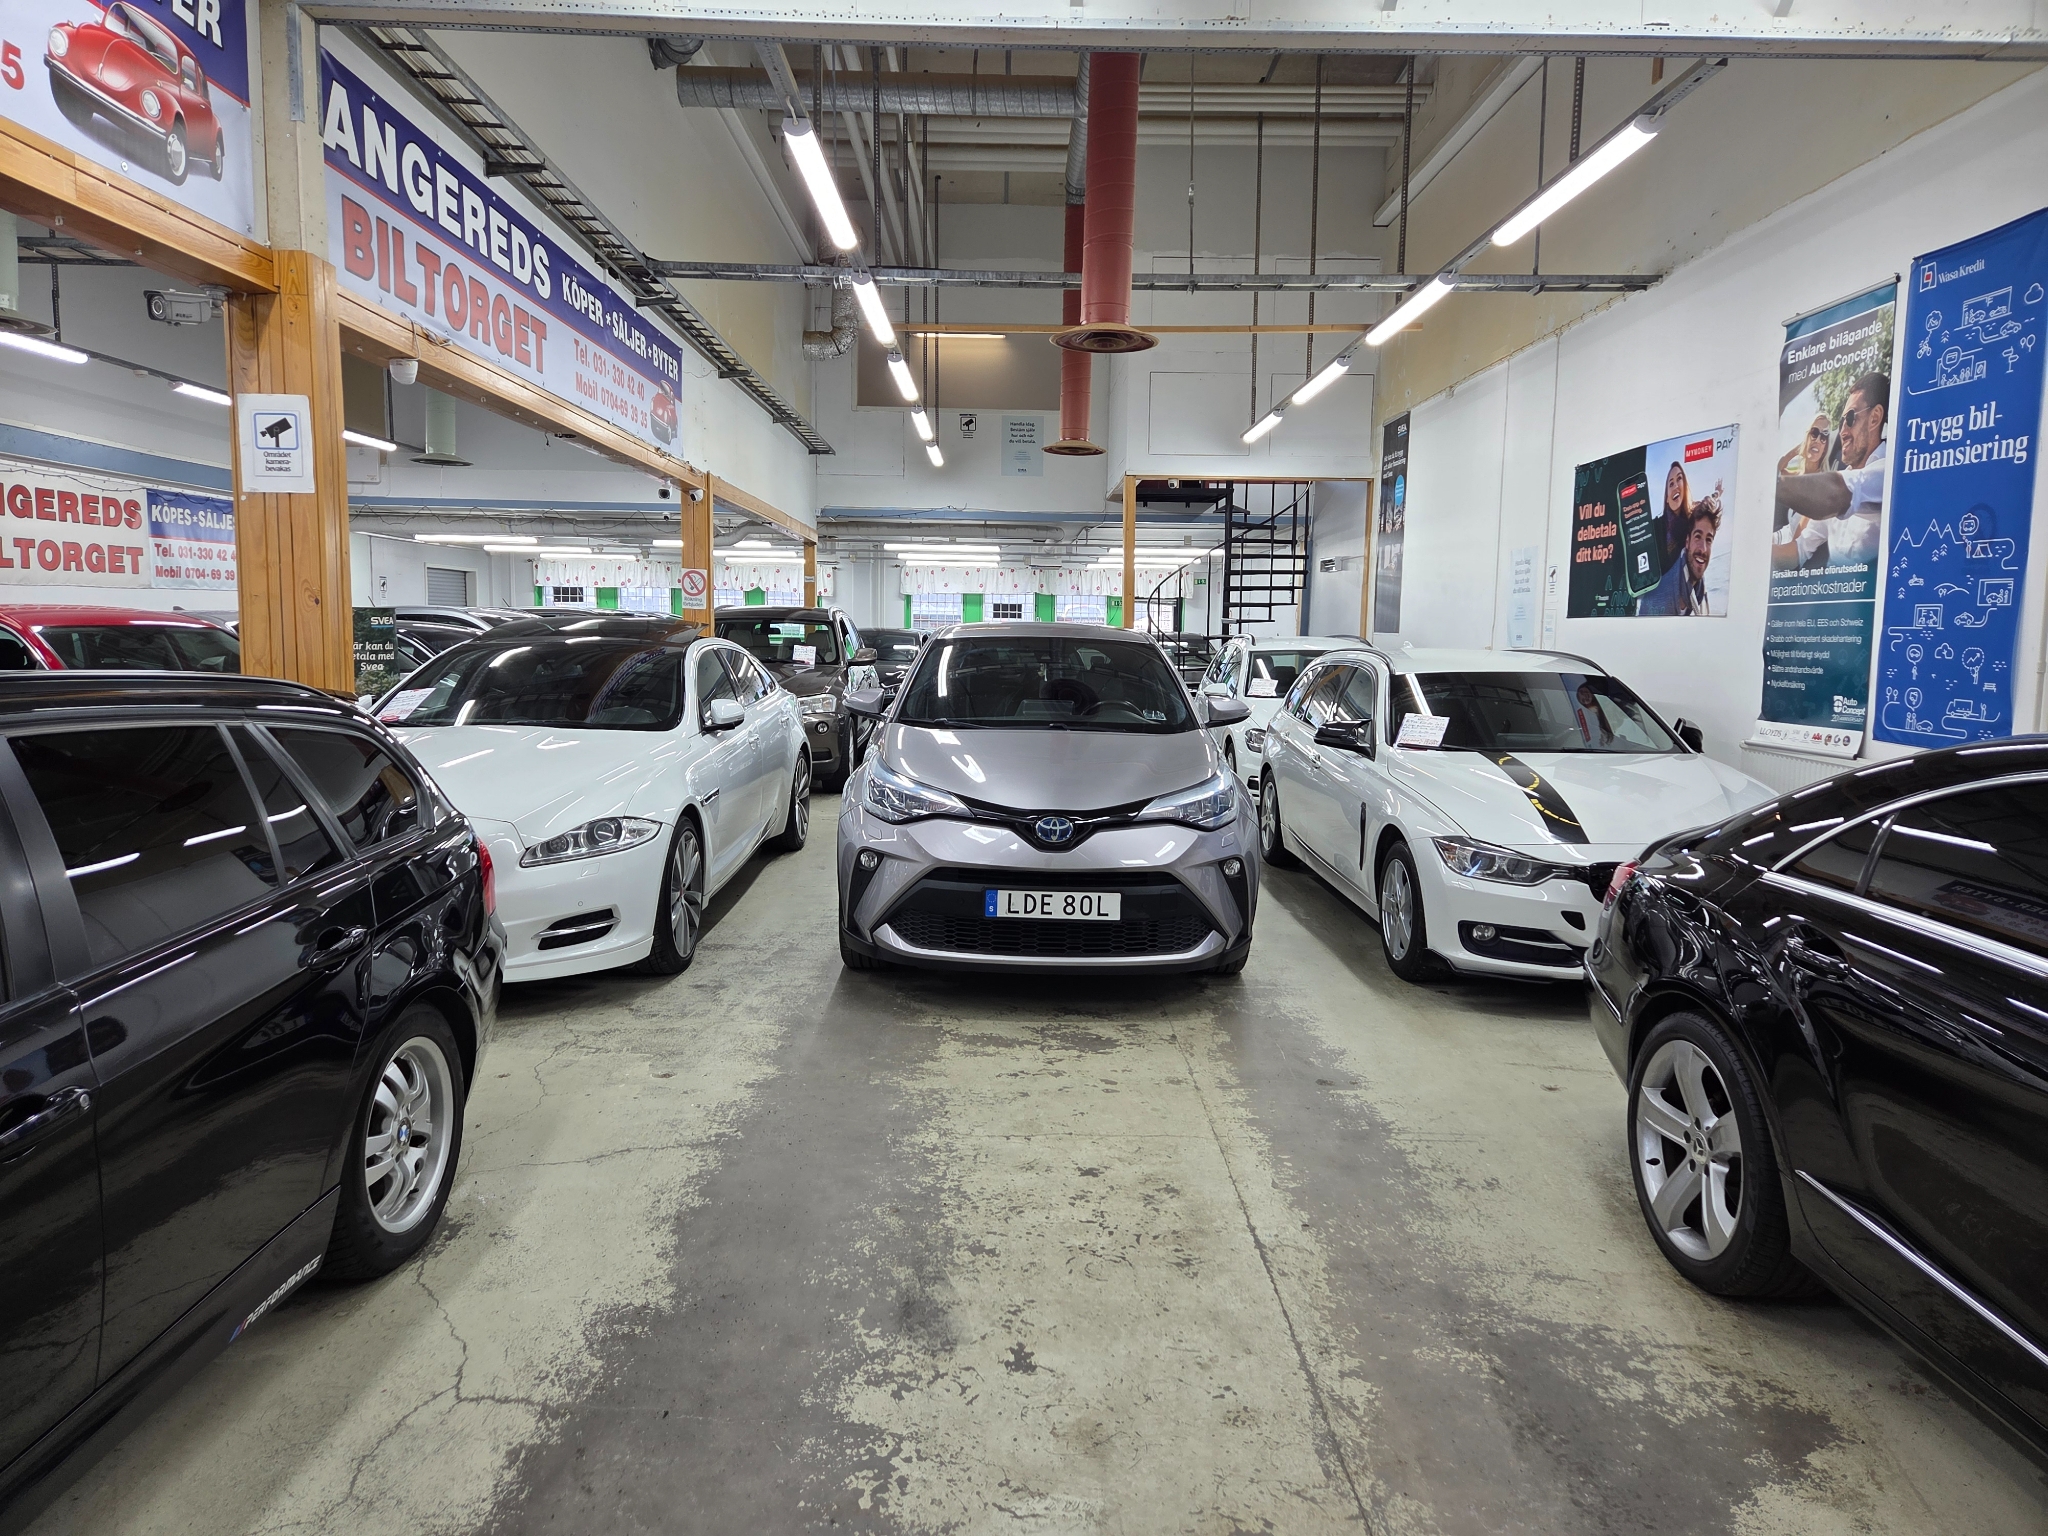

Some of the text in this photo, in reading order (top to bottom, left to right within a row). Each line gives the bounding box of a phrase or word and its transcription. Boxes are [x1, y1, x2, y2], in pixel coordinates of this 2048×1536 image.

[323, 80, 551, 300] ANGEREDS
[1938, 258, 1985, 284] Wasa Kredit
[341, 193, 547, 374] BILTORGET
[561, 272, 679, 382] KÖPER SÄLJER BYTER
[1787, 320, 1883, 365] Enklare bilägande
[573, 338, 590, 368] Tel.
[612, 363, 625, 389] 330
[626, 374, 635, 394] 42
[637, 380, 645, 401] 40
[1788, 341, 1880, 384] med AutoConcept
[575, 372, 648, 429] Mobil 0704-69 39 35
[1907, 401, 2003, 445] Trygg bil-
[1716, 437, 1734, 451] PAY
[1902, 435, 2029, 474] finansiering
[0, 482, 143, 530] GEREDS
[151, 503, 192, 526] KÖPES
[1579, 503, 1593, 520] Vill
[1593, 502, 1606, 518] du
[1577, 521, 1617, 542] delbetala
[154, 543, 174, 558] Tel.
[178, 545, 213, 560] 031-330
[217, 548, 227, 562] 42
[1575, 543, 1614, 564] ditt köp?
[155, 565, 235, 581] Mobil 0704-69 39
[1772, 562, 1868, 579] Försäkra dig mot oförutsedda
[1771, 578, 1867, 599] reparationskostnader
[370, 616, 394, 625] SVEA
[1806, 618, 1816, 628] EU,
[1817, 618, 1829, 627] EES
[1829, 618, 1839, 627] och
[1840, 617, 1864, 627] Schweiz
[353, 641, 394, 651] är kan du
[1770, 634, 1862, 645] Snabb och kompetent skadehantering
[353, 650, 395, 661] etala med
[1813, 650, 1830, 660] skydd
[360, 662, 384, 671] Svea
[1842, 705, 1866, 717] Concept
[1843, 697, 1858, 706] Auto
[1007, 892, 1109, 917] LDE 80L
